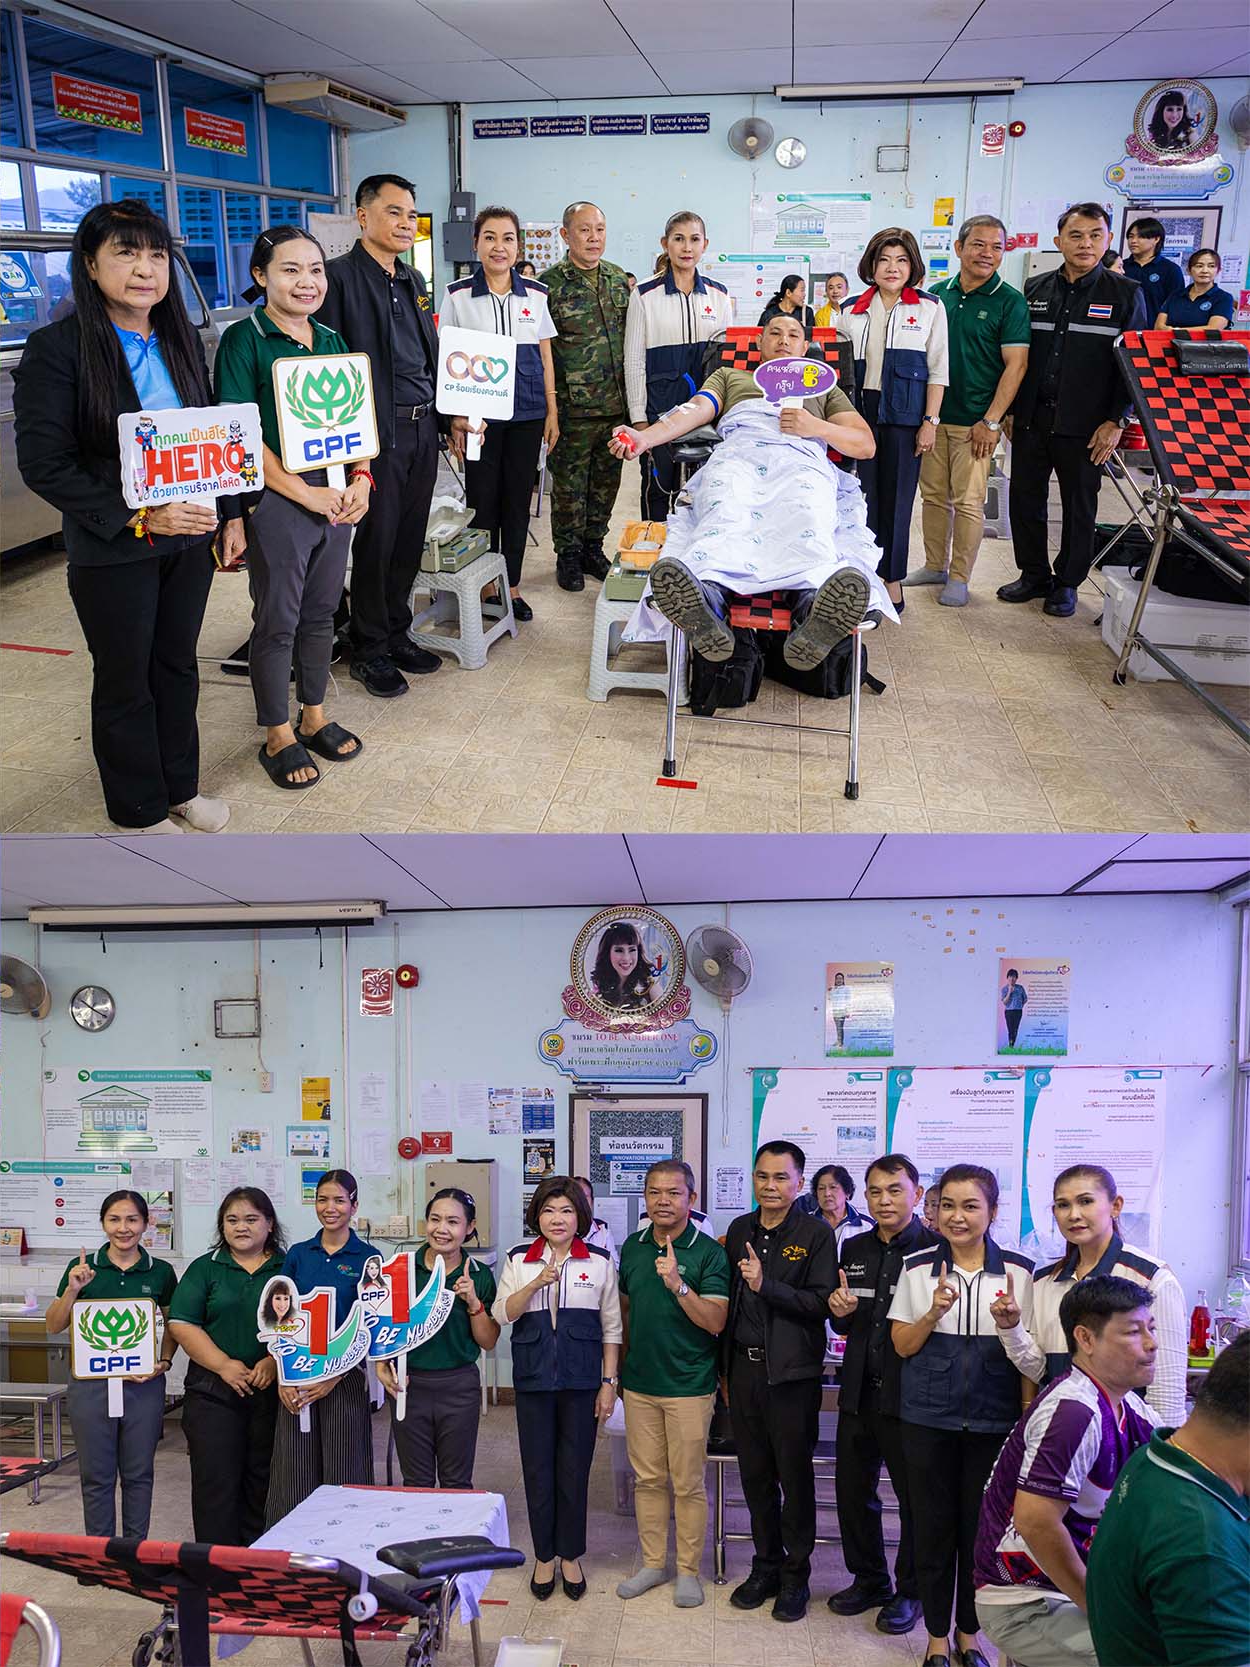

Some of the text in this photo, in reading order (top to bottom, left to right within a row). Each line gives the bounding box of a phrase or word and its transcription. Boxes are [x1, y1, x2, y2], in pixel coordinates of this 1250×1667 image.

[444, 383, 508, 398] CP ร้อยเรียงความดี
[154, 425, 227, 449] ทุกคนเป็นฮีโร่
[304, 432, 362, 462] CPF
[143, 442, 246, 487] HERO
[152, 477, 240, 499] ด้วยการบริจาคโลหิต
[608, 1140, 664, 1150] ห้องนวัตกรรม
[362, 1290, 386, 1302] CPF
[375, 1326, 402, 1346] BE
[90, 1356, 141, 1372] CPF
[274, 1339, 297, 1356] TO
[292, 1356, 318, 1372] BE
